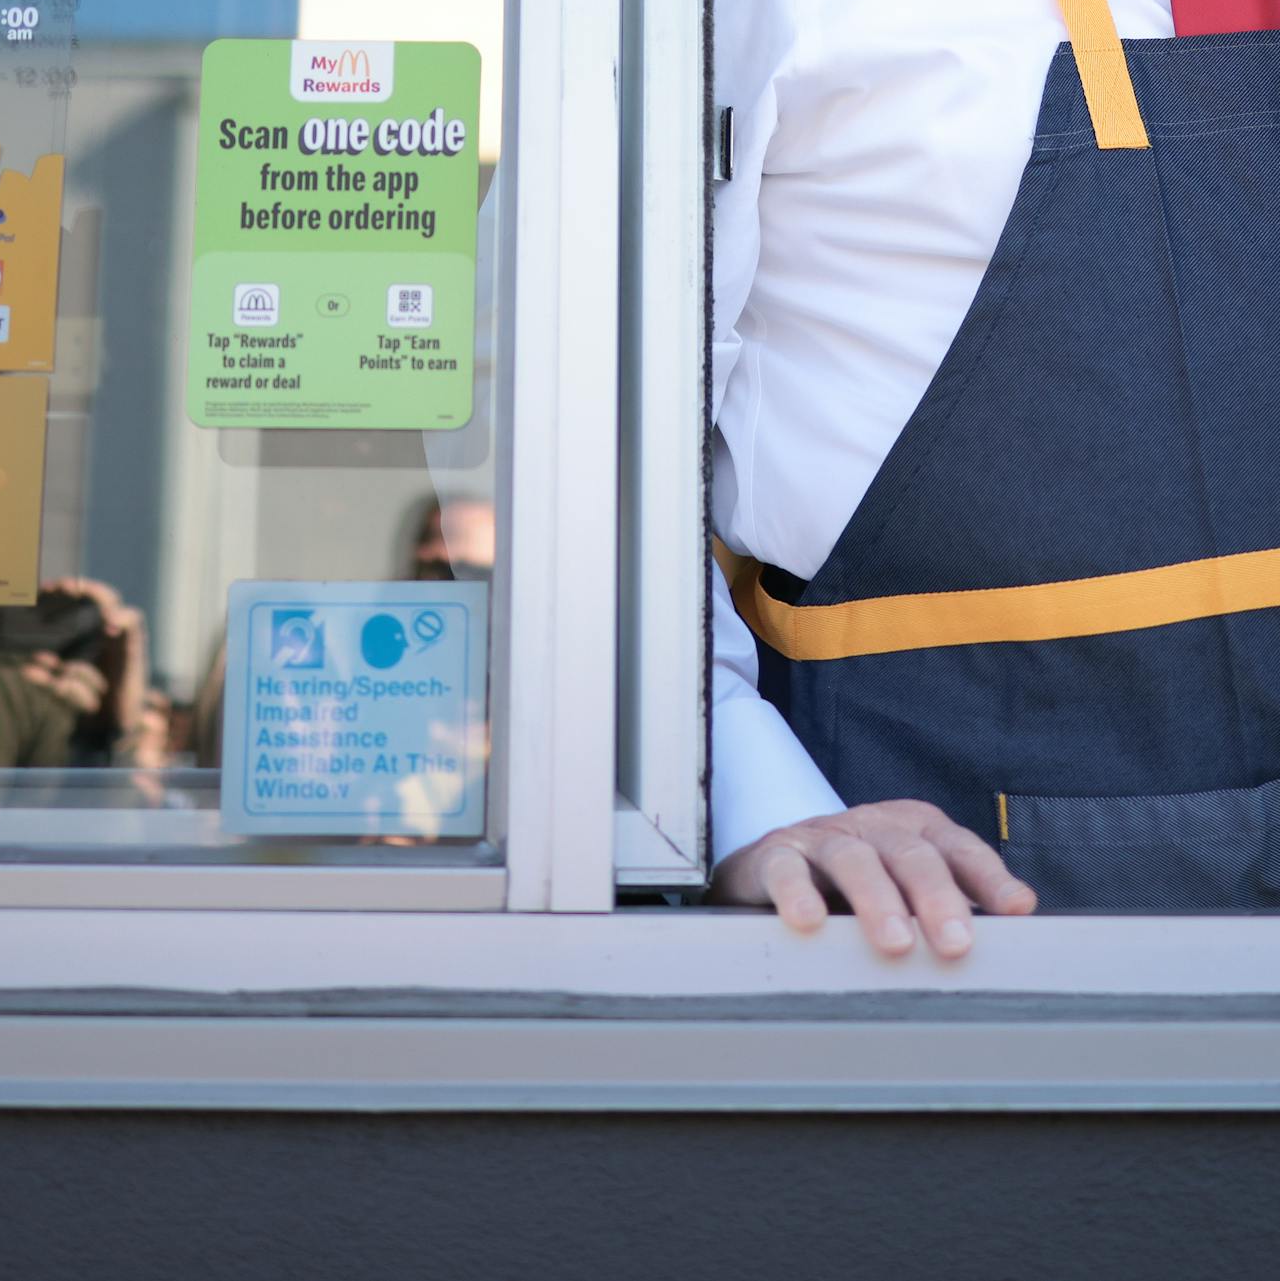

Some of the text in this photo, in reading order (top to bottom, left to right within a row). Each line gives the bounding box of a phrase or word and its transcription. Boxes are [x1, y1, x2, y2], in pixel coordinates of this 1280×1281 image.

[7, 28, 33, 41] am
[311, 56, 338, 73] My
[303, 78, 381, 93] Rewards
[219, 107, 465, 156] Scan one code
[260, 163, 419, 200] from the app
[240, 202, 436, 238] before ordering
[327, 300, 339, 311] Or
[207, 333, 230, 350] Tap
[378, 335, 400, 350] Tap
[222, 354, 286, 369] to claim a
[411, 357, 424, 371] to
[428, 359, 457, 371] earn
[206, 374, 301, 390] reward or deal
[256, 675, 451, 700] Hearing/Speech-
[372, 755, 397, 774] At
[406, 754, 457, 774] This
